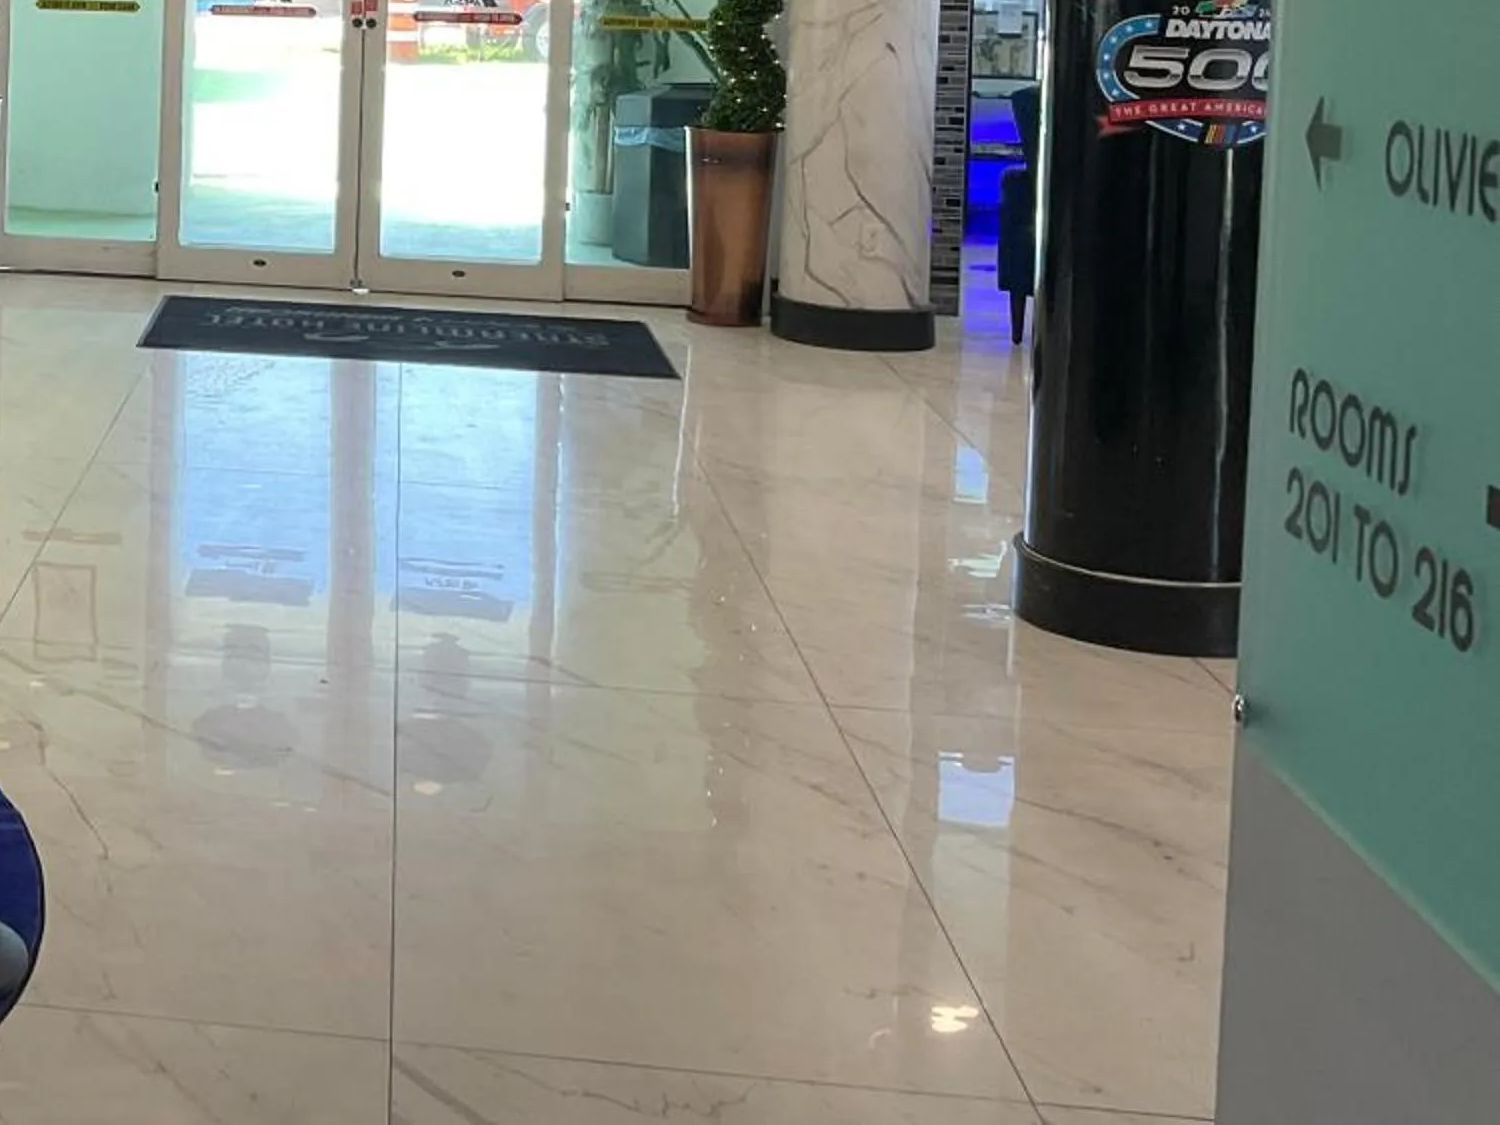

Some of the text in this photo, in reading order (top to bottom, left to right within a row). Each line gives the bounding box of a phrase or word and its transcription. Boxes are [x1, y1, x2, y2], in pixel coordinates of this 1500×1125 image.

[1171, 6, 1190, 15] 20
[1165, 18, 1271, 41] DAYTONA
[1115, 102, 1267, 118] THE GREAT AMERICA
[1289, 367, 1417, 496] ROOMS
[1284, 467, 1474, 653] 201 TO 216
